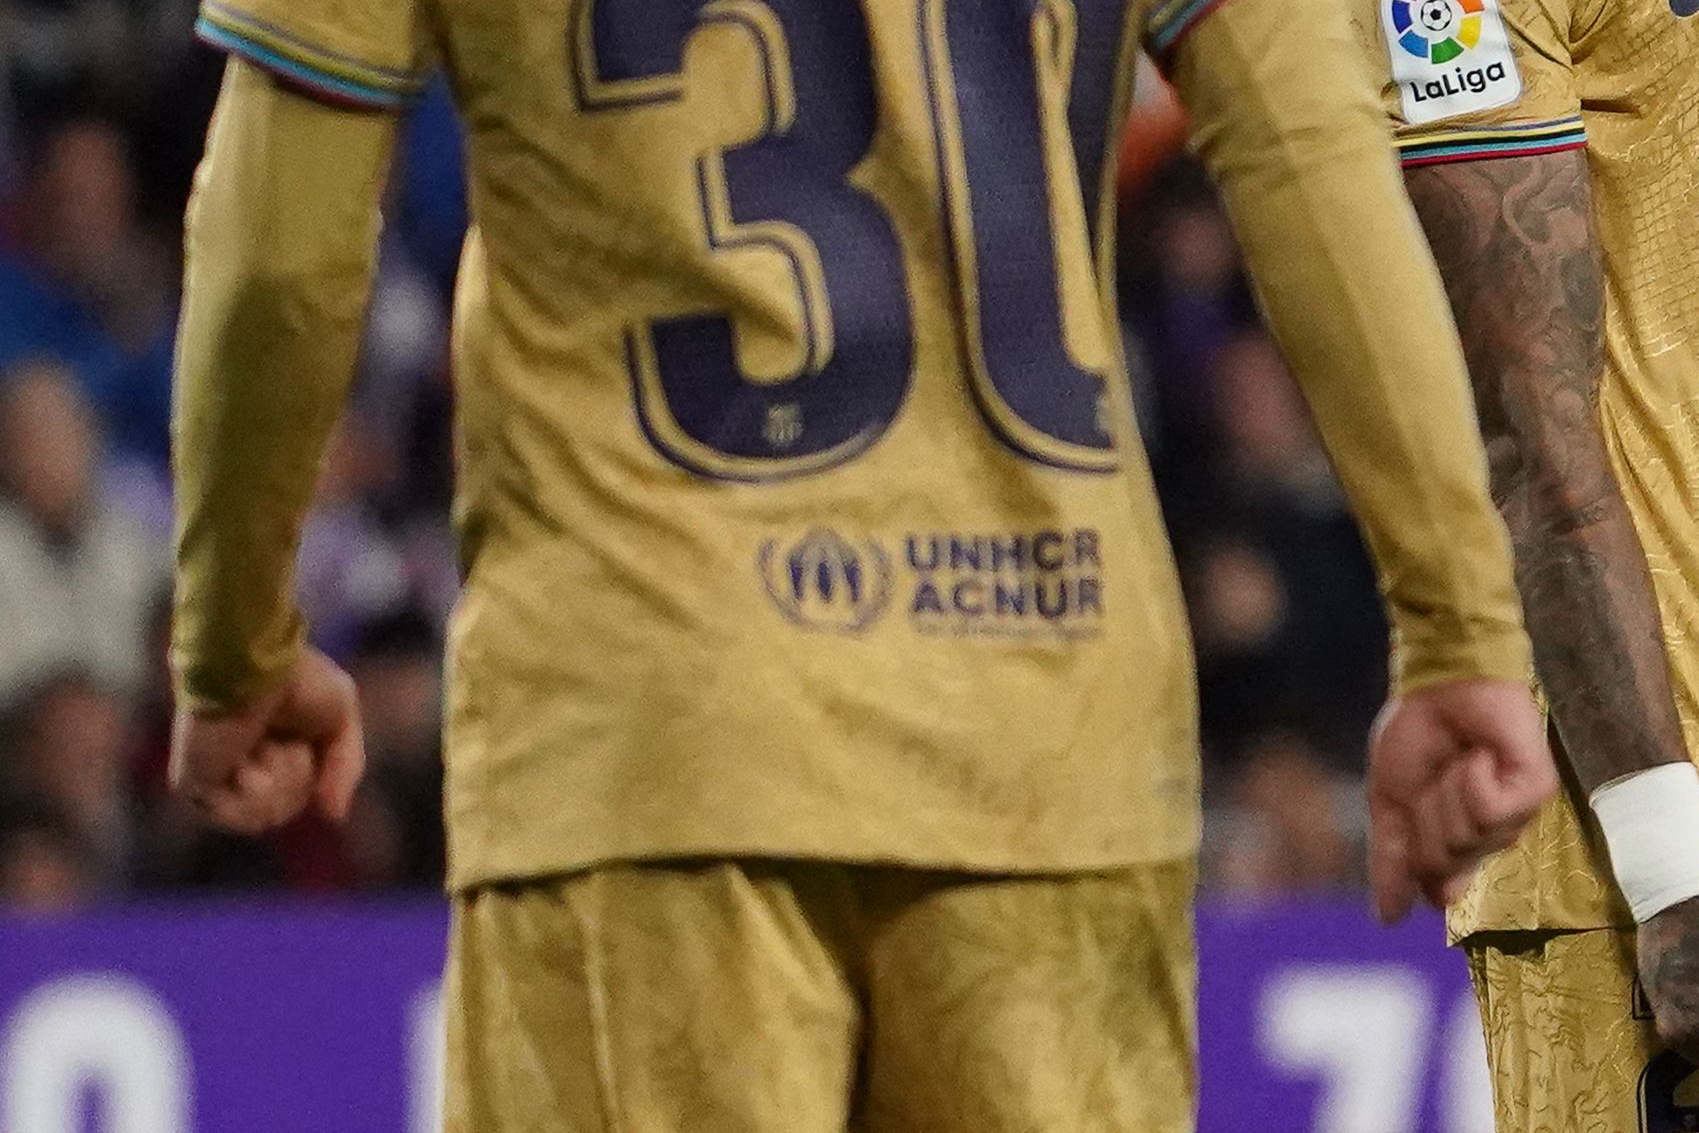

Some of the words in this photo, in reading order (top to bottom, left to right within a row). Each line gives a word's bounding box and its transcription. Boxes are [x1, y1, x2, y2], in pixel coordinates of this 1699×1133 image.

[1410, 61, 1507, 103] LaLiga
[904, 527, 1101, 574] UNHCR
[912, 576, 1103, 620] ACNUR
